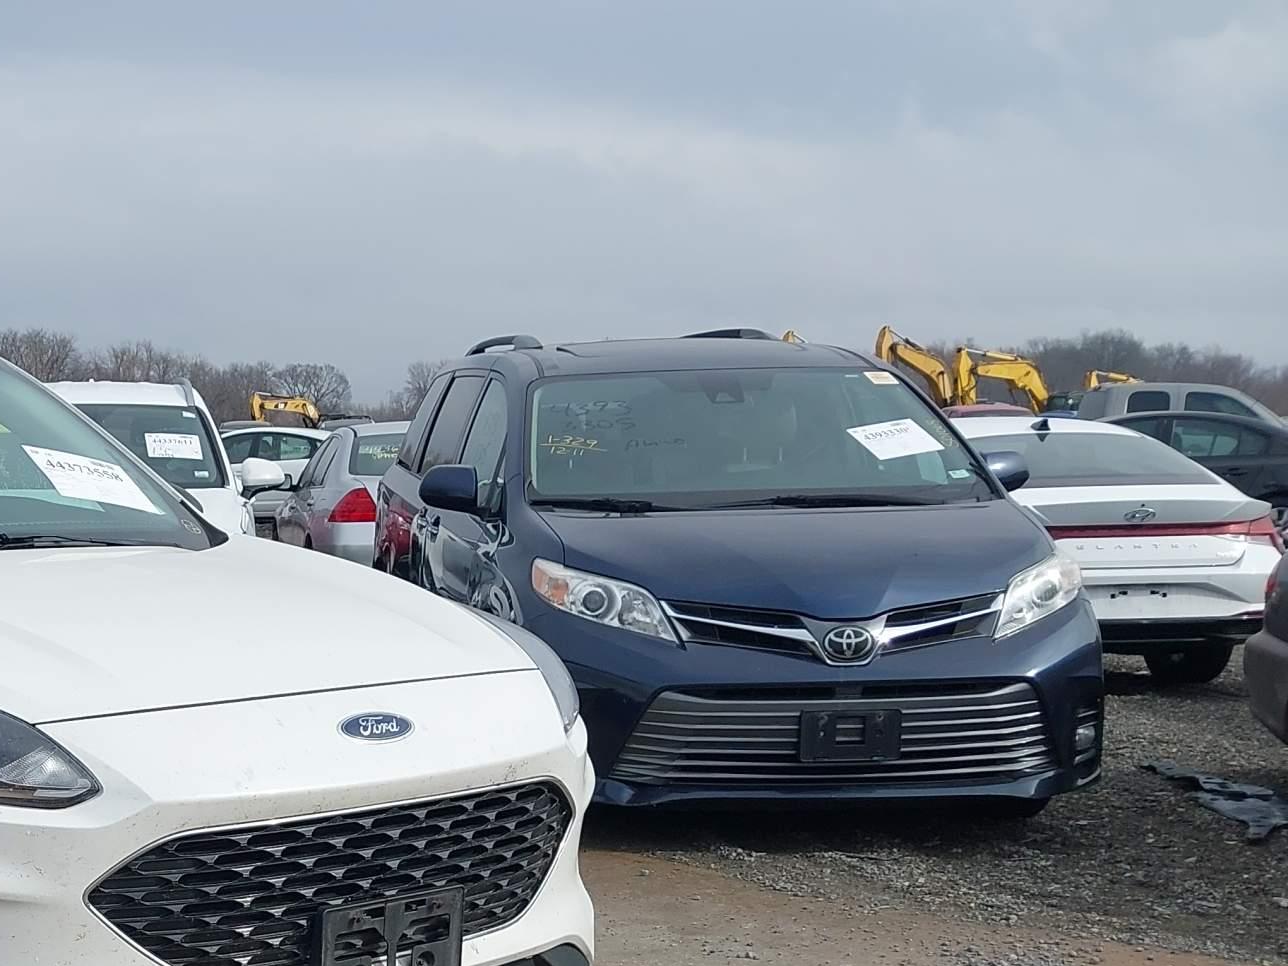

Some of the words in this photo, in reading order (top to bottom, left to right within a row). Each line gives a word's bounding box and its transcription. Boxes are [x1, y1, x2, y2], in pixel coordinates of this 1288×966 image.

[46, 458, 124, 482] 44373558
[1076, 542, 1199, 551] ELANTRA
[358, 716, 400, 736] Ford
